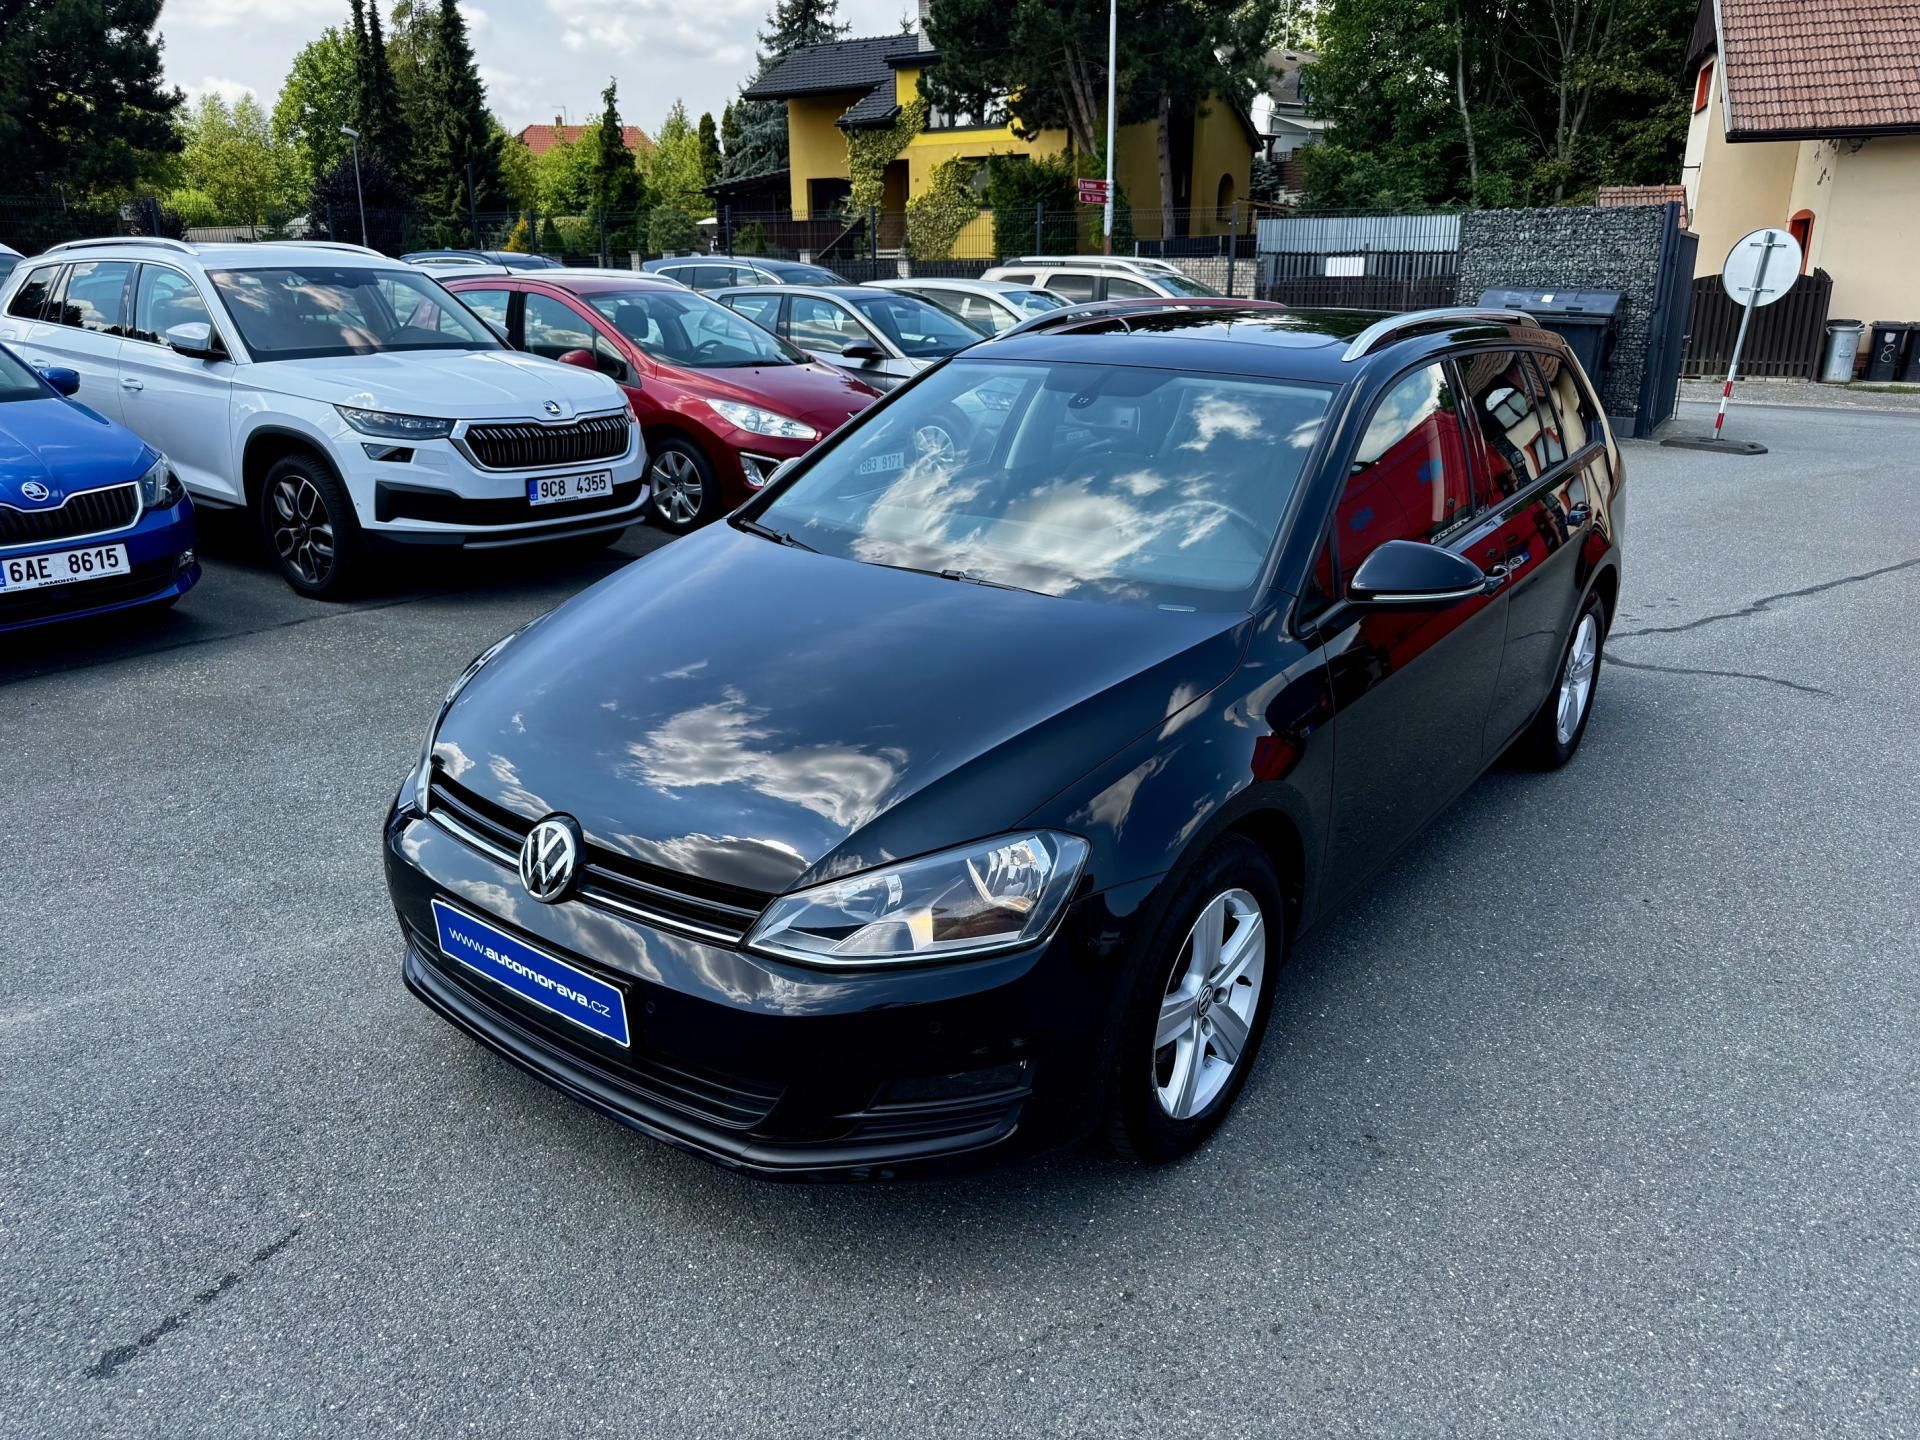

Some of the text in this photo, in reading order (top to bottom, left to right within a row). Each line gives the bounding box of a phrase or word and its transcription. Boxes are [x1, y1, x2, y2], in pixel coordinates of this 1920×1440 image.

[541, 474, 607, 498] 9C8 4355
[9, 548, 119, 582] 6AE 8615
[448, 927, 612, 1019] www.automorava.cz
